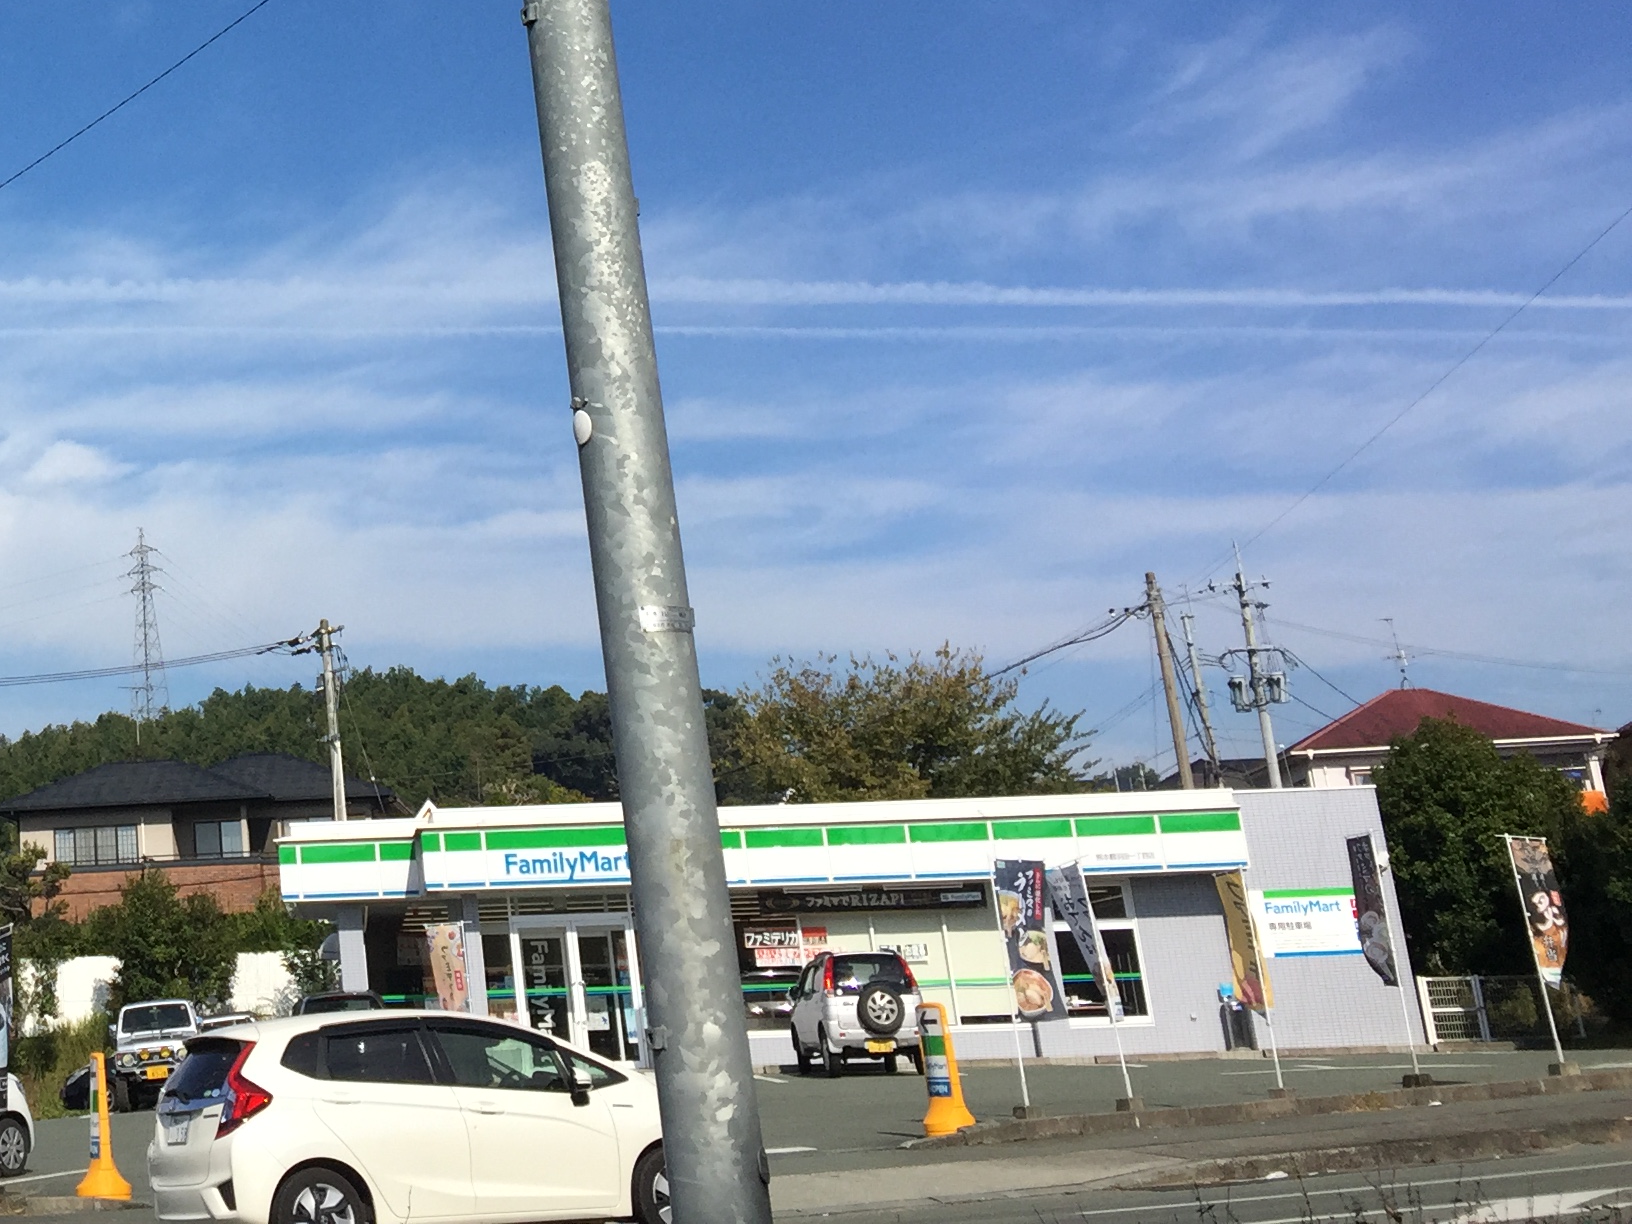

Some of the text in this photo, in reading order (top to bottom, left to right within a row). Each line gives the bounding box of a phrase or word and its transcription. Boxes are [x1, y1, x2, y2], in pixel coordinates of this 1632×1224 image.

[504, 851, 630, 882] FamilyMart
[1264, 899, 1342, 916] FamilyMart
[745, 930, 799, 946] ファミデリカ
